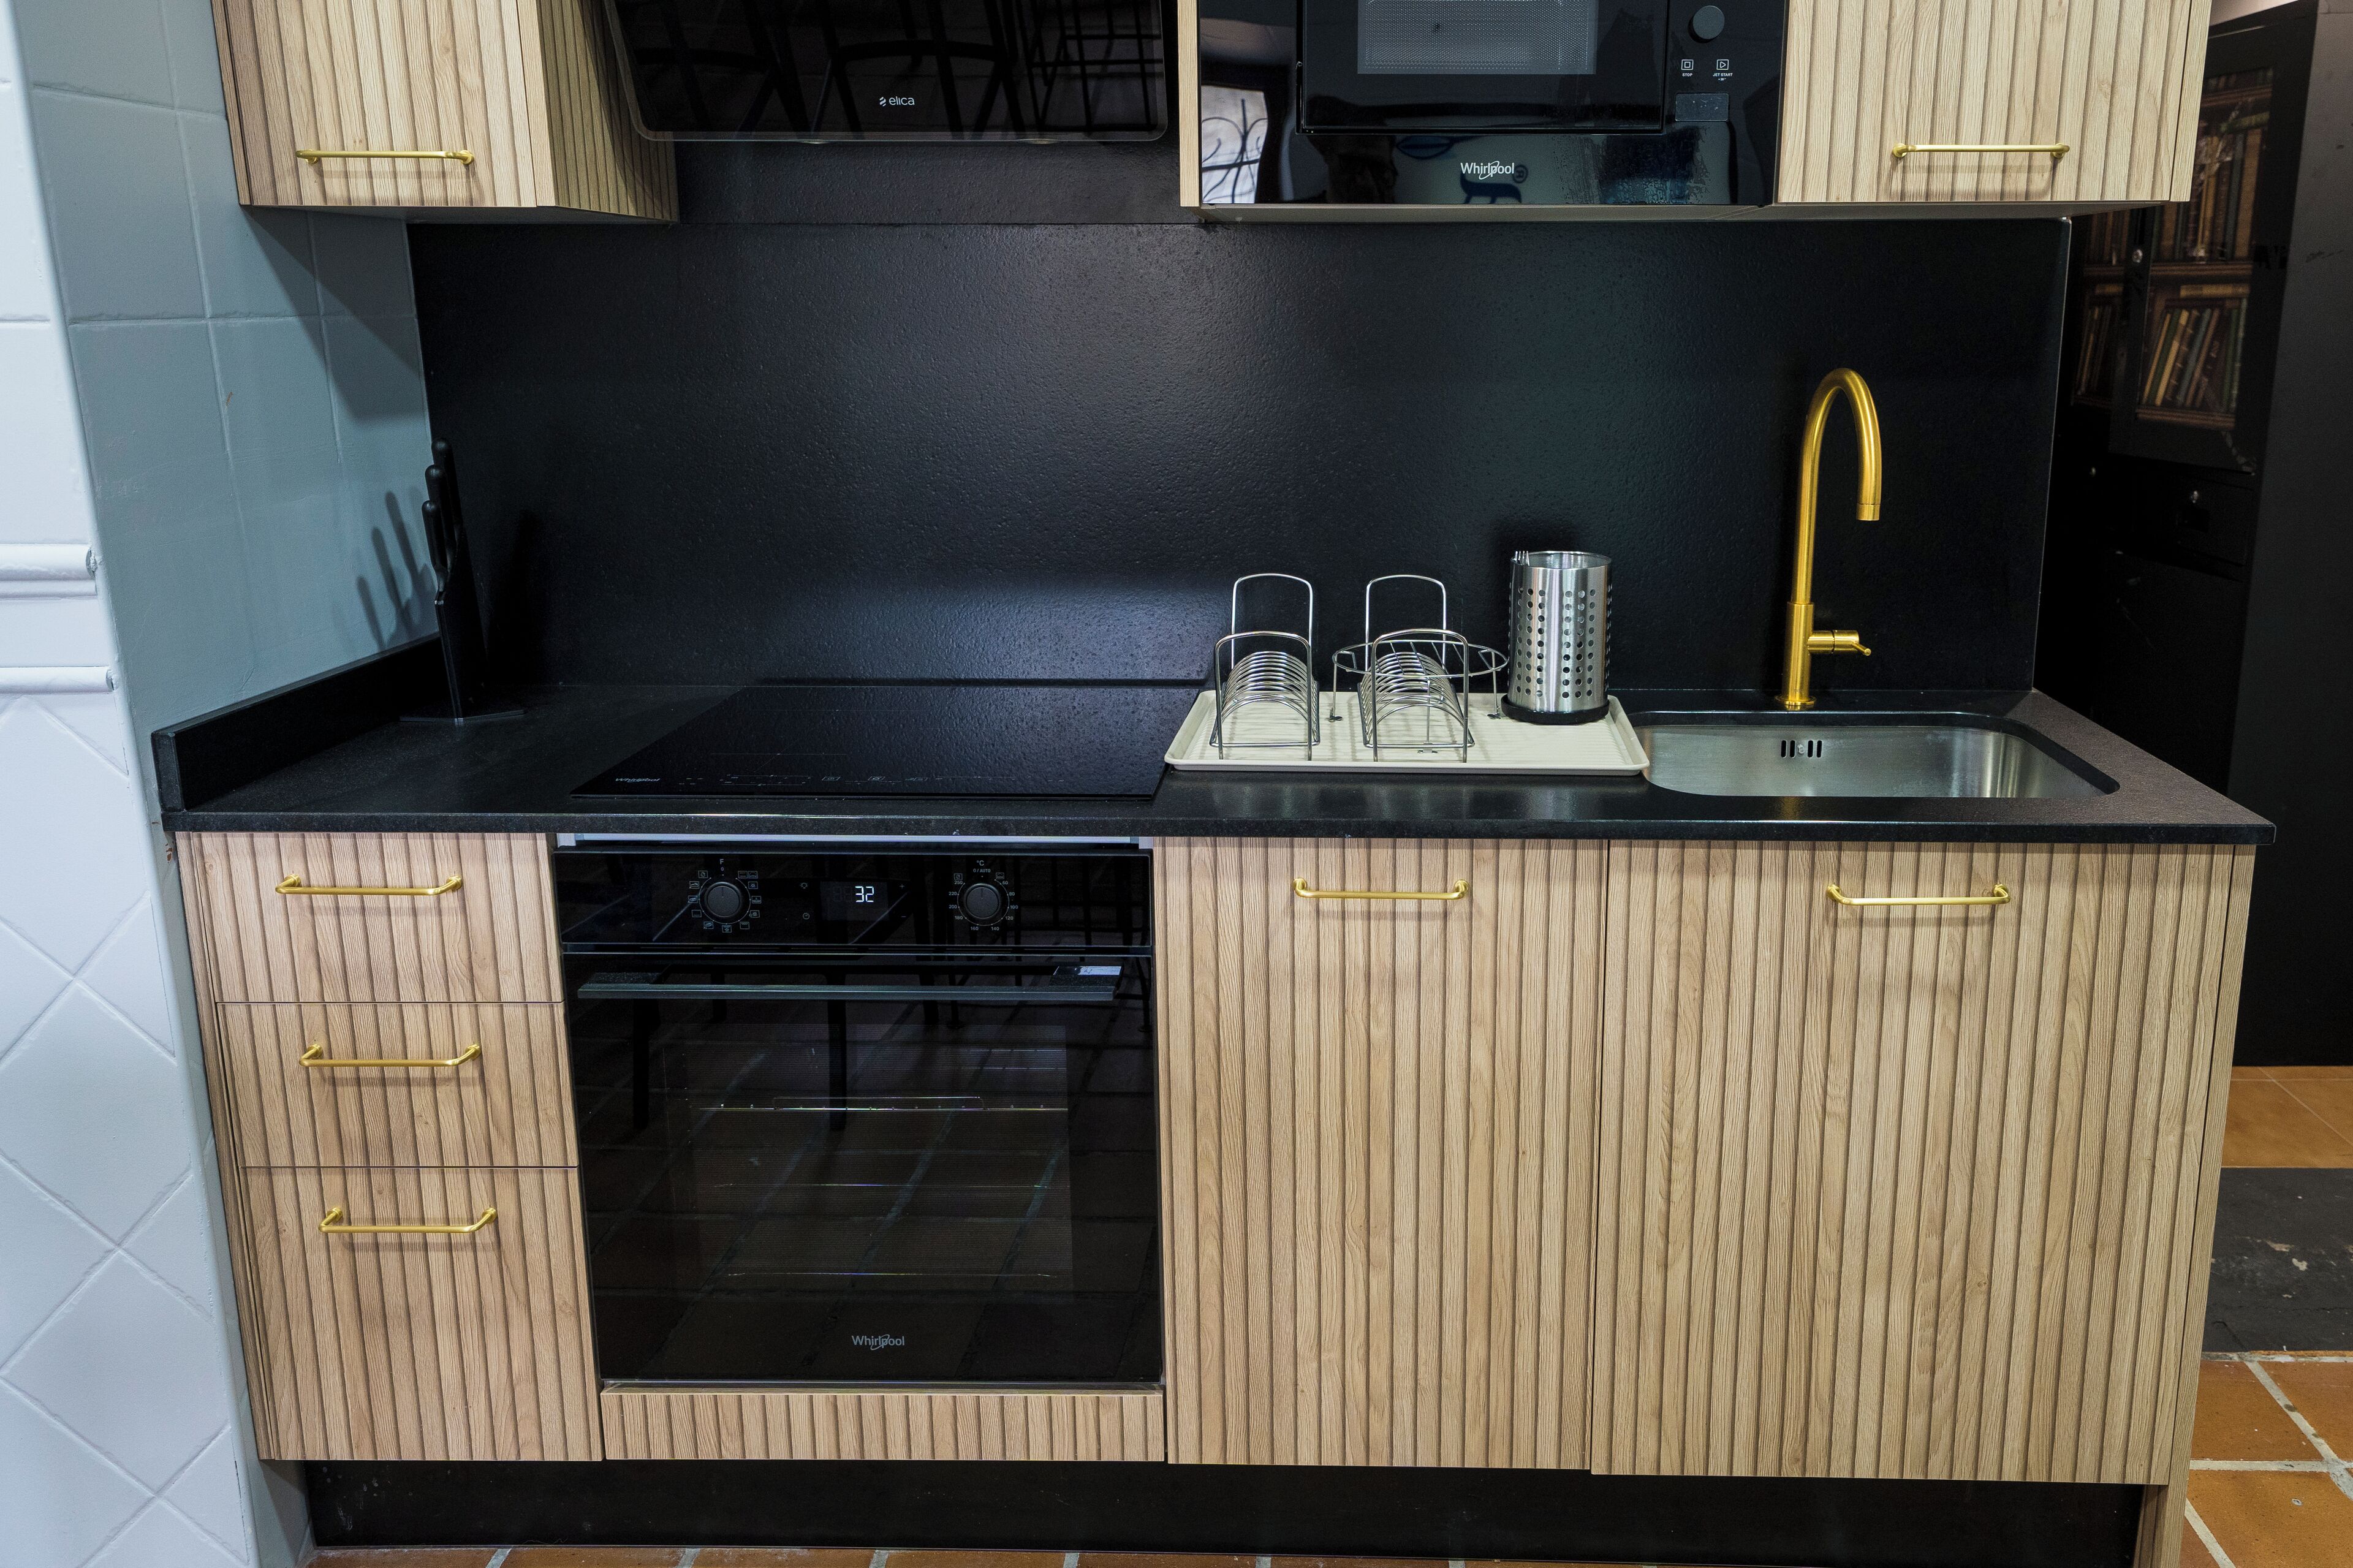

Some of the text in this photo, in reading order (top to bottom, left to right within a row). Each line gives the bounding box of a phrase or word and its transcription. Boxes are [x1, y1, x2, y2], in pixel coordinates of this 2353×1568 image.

[889, 96, 915, 105] elica
[1460, 161, 1515, 180] Whirlpool
[855, 886, 874, 903] 32
[852, 1334, 904, 1350] Whirlpool
